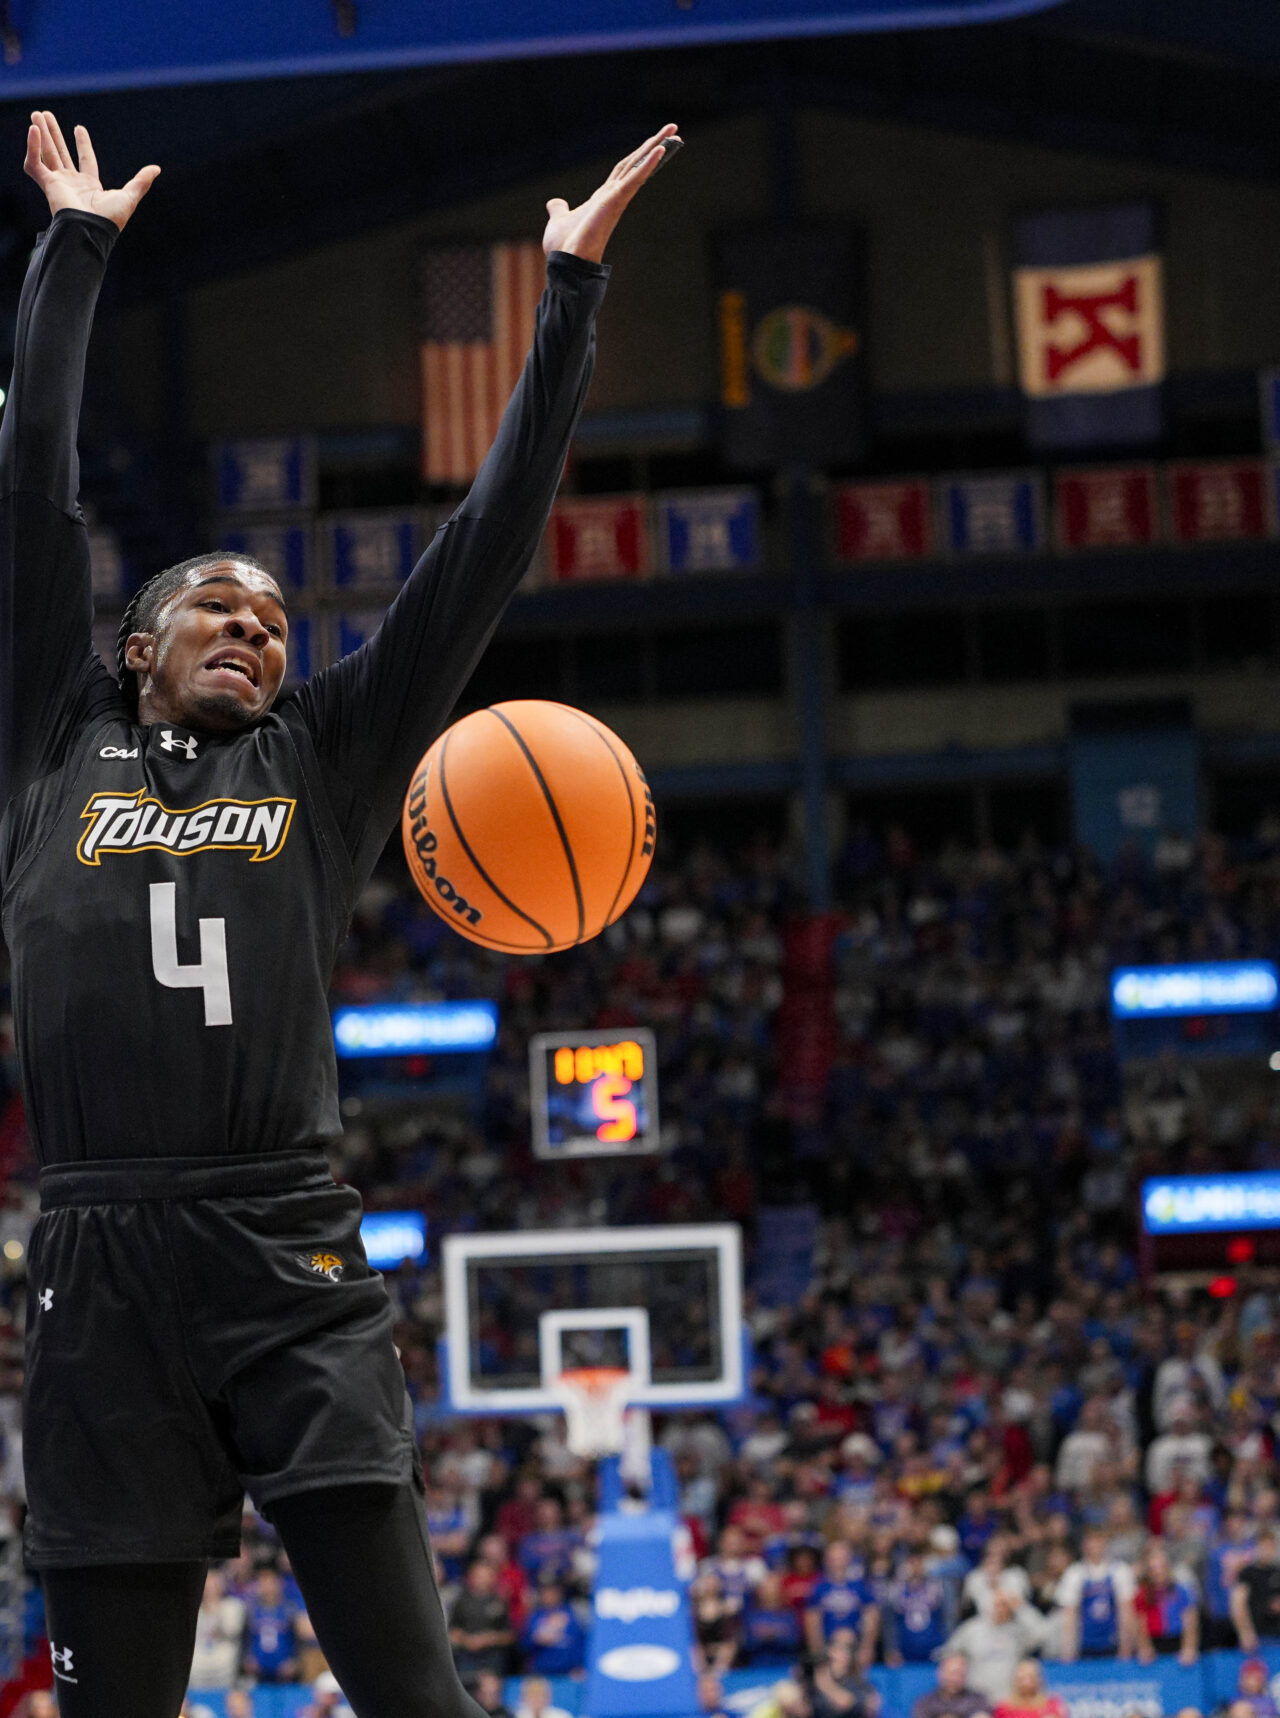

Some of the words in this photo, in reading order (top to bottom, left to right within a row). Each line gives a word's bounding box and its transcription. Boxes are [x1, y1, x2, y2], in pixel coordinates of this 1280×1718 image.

[99, 746, 139, 760] CAA
[81, 794, 291, 861] TOWSON
[408, 762, 483, 927] Wilson
[149, 881, 233, 1027] 4
[591, 1073, 637, 1142] 5
